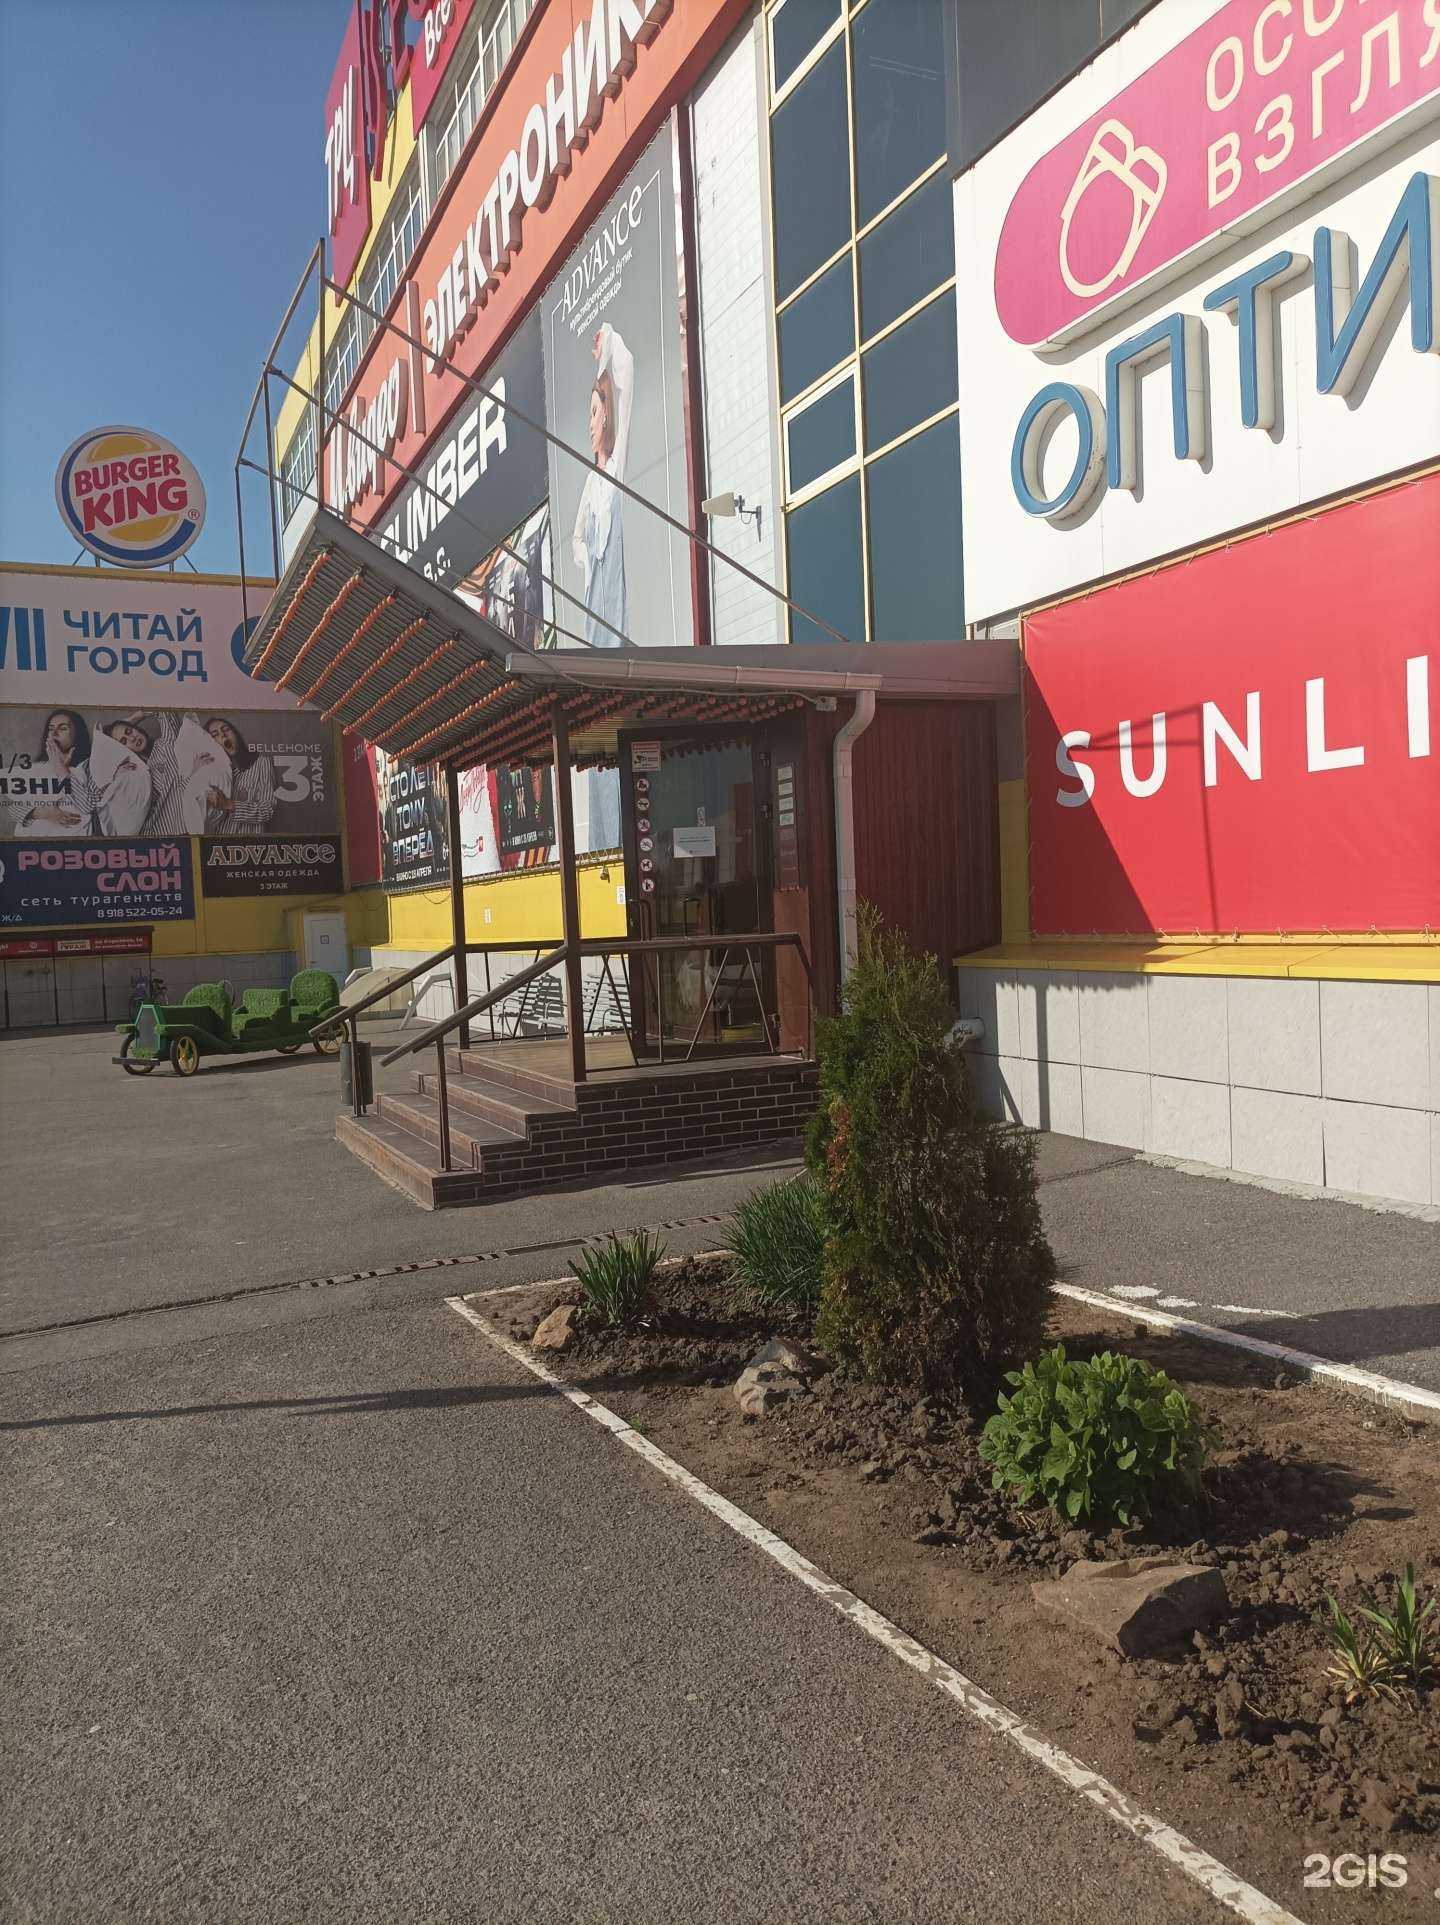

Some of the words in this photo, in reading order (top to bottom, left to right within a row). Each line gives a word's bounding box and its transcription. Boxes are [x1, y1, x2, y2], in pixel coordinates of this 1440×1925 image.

[424, 0, 658, 375] ЭЛЕКТРОНИК
[74, 453, 180, 498] BURGER
[82, 478, 189, 534] KING
[63, 608, 203, 643] ЧИТАЙ
[67, 645, 208, 682] ГОРОД
[248, 743, 321, 753] BELLEHOME
[273, 755, 311, 802] 3
[311, 755, 325, 802] ЭТАЖ
[18, 843, 181, 871] РОЗОВЫЙ
[97, 870, 182, 893] СЛОН
[226, 871, 275, 879] ЖЕНСКАЯ
[277, 869, 320, 878] ОДЕЖДА
[266, 882, 289, 890] ЭТАЖ
[21, 896, 62, 907] сеть
[70, 892, 183, 907] турагентств
[97, 908, 105, 918] 8
[107, 908, 124, 918] 918
[126, 906, 183, 918] 522-05-24
